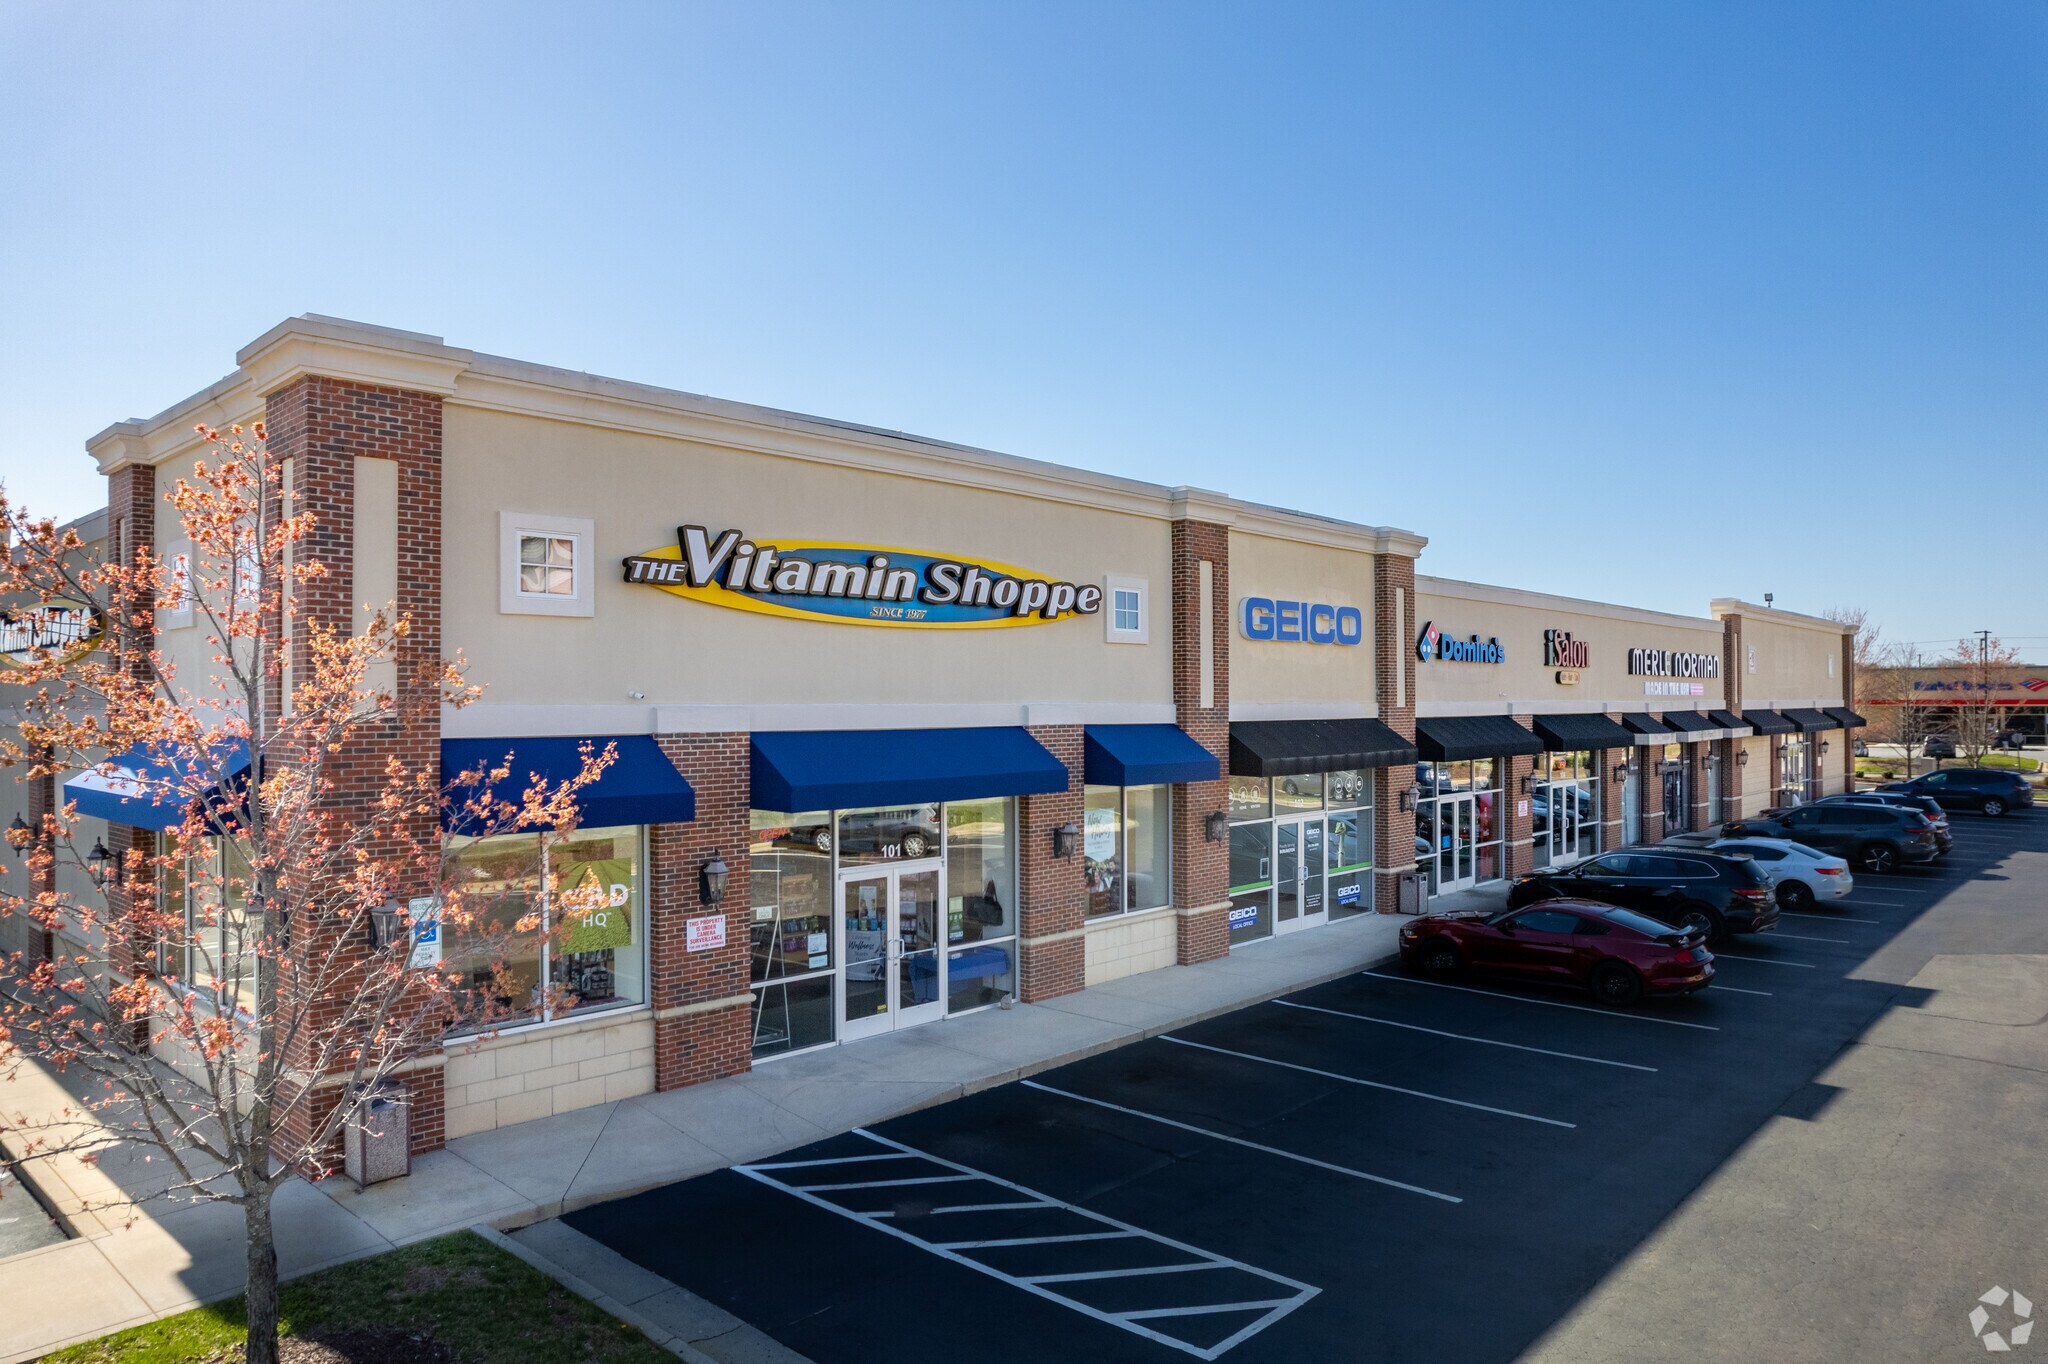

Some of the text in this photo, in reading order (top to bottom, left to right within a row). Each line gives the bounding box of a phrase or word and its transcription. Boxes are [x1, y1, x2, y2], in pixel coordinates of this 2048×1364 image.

[628, 525, 1102, 619] THE Vitamin Shoppe
[870, 607, 928, 619] SINCE 1977
[1240, 597, 1361, 645] GEICO
[1440, 633, 1505, 664] Domino's
[1545, 629, 1590, 668] iSalon
[1629, 648, 1719, 679] MERLE NORMAN
[1644, 682, 1661, 695] MADE
[1306, 828, 1320, 836] GEICO
[881, 844, 901, 858] 101
[1337, 884, 1360, 896] GEICO
[1229, 906, 1257, 920] GEICO
[583, 913, 607, 928] HQ
[700, 917, 724, 926] PROPERTY
[1232, 920, 1254, 930] LOCAL OFFICE
[690, 935, 723, 944] SURVEILLANCE
